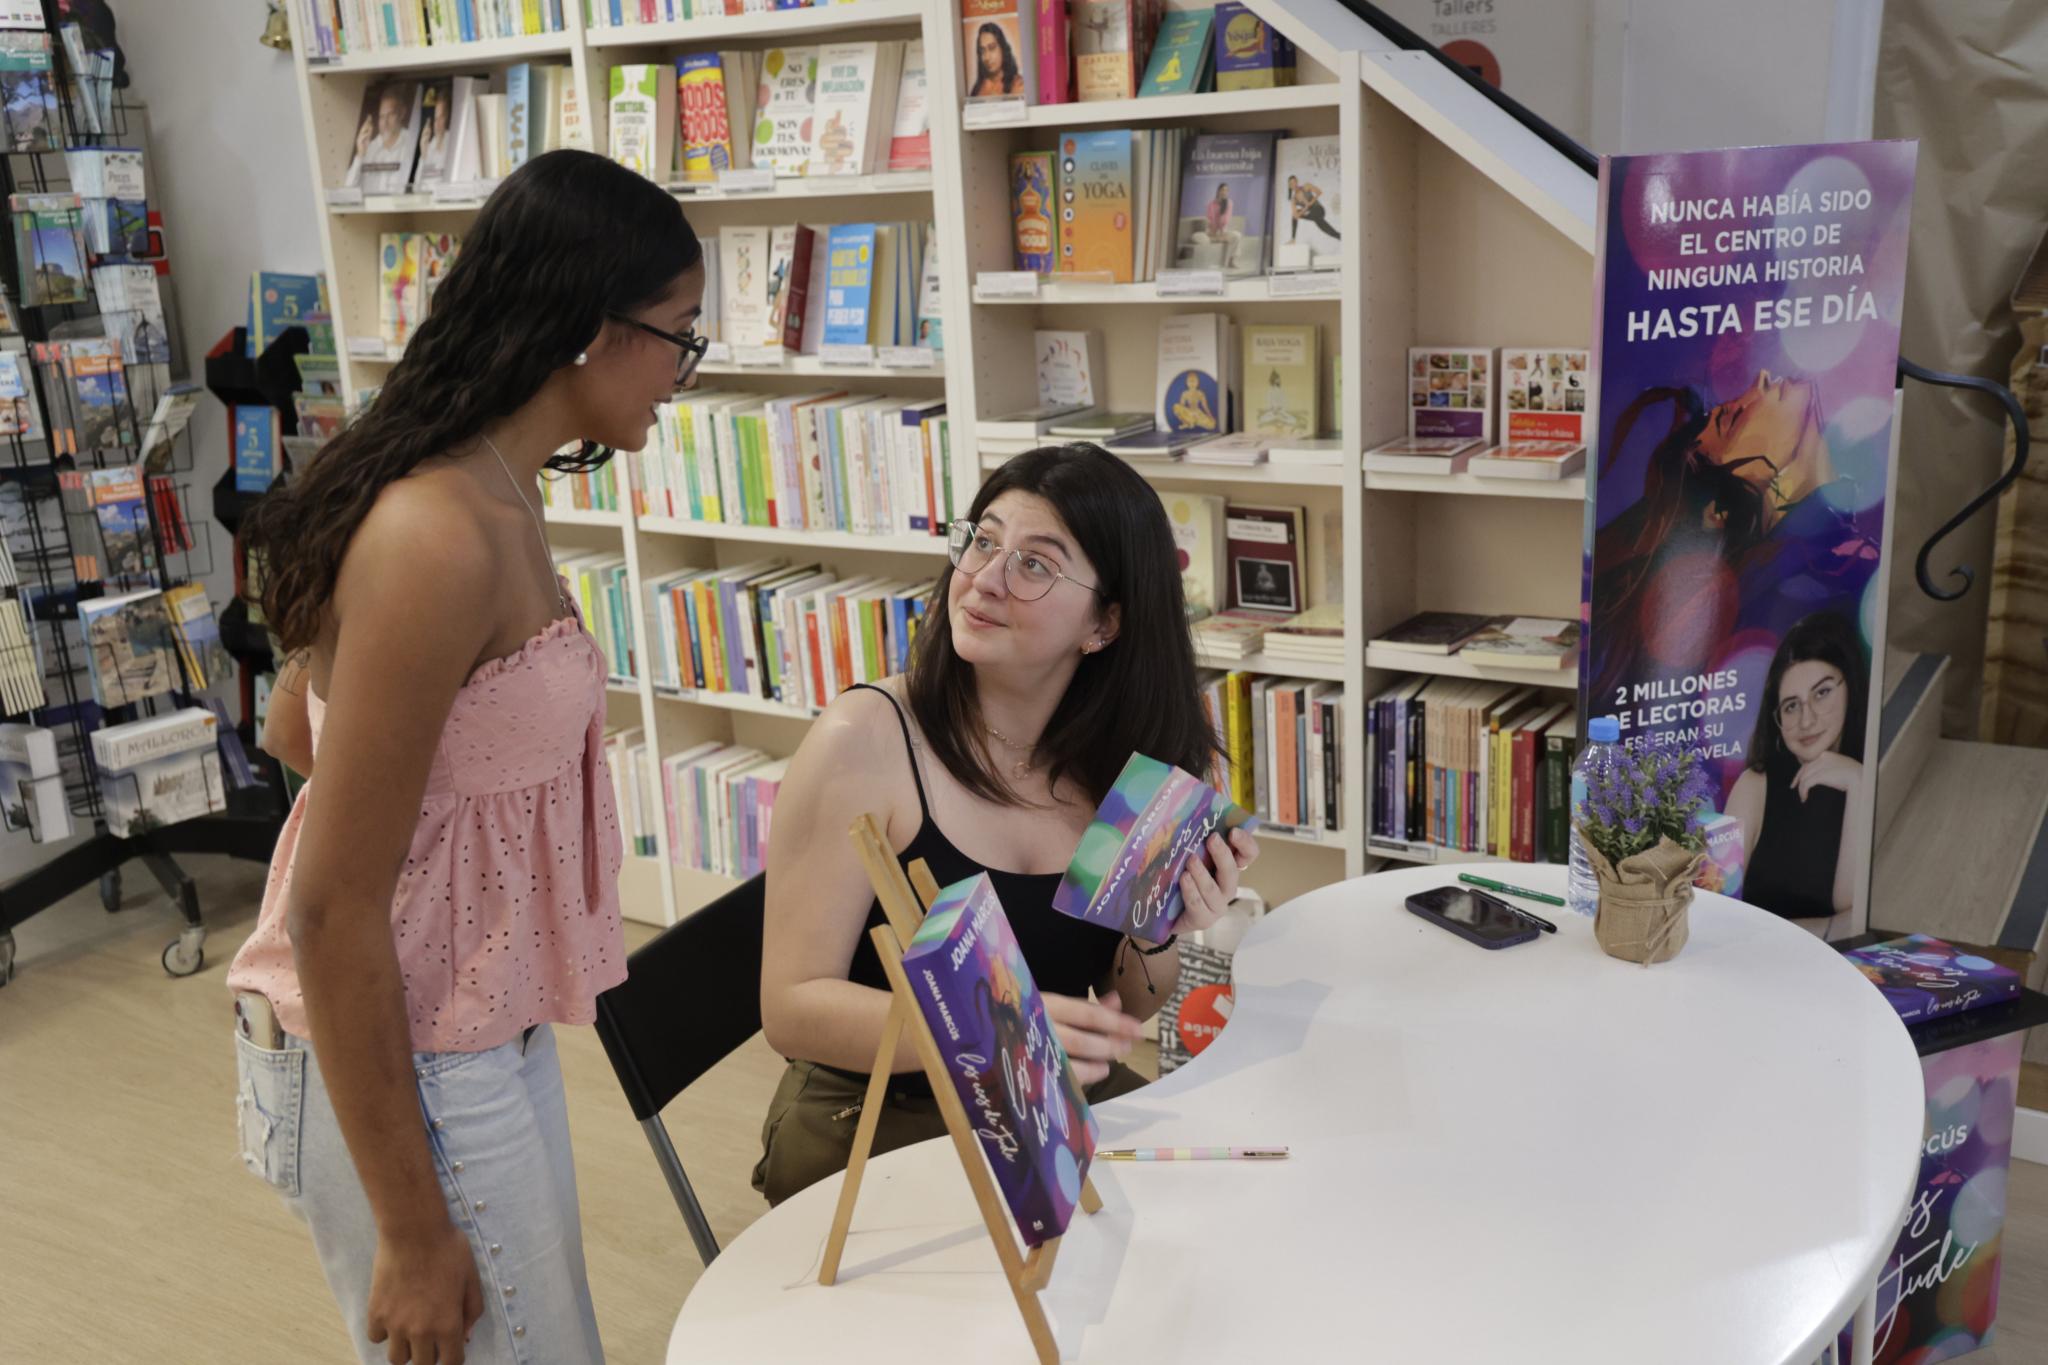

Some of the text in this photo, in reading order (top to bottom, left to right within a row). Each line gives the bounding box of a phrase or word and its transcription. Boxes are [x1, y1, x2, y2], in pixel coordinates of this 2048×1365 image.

[1433, 0, 1494, 17] Tallers
[1430, 19, 1496, 36] TALLERES
[1083, 182, 1127, 200] YOGA
[1650, 188, 1872, 224] NUNCA HABÍA SIDO
[1679, 224, 1842, 255] EL CENTRO DE
[1648, 254, 1864, 291] NINGUNA HISTORIA
[1627, 285, 1878, 342] HASTA ESE DÍA
[1615, 669, 1738, 705] 2 MILLONES
[1637, 692, 1747, 727] LECTORAS
[1624, 721, 1724, 749] ESERAN SU
[1096, 855, 1132, 915] JOANA
[1132, 876, 1161, 928] Los
[951, 927, 977, 972] JOANA
[922, 968, 960, 1041] JOANA MARCÚS
[955, 1053, 986, 1080] Los
[984, 1107, 1001, 1126] de
[1903, 1188, 1943, 1238] os
[1872, 1229, 1978, 1362] Jude
